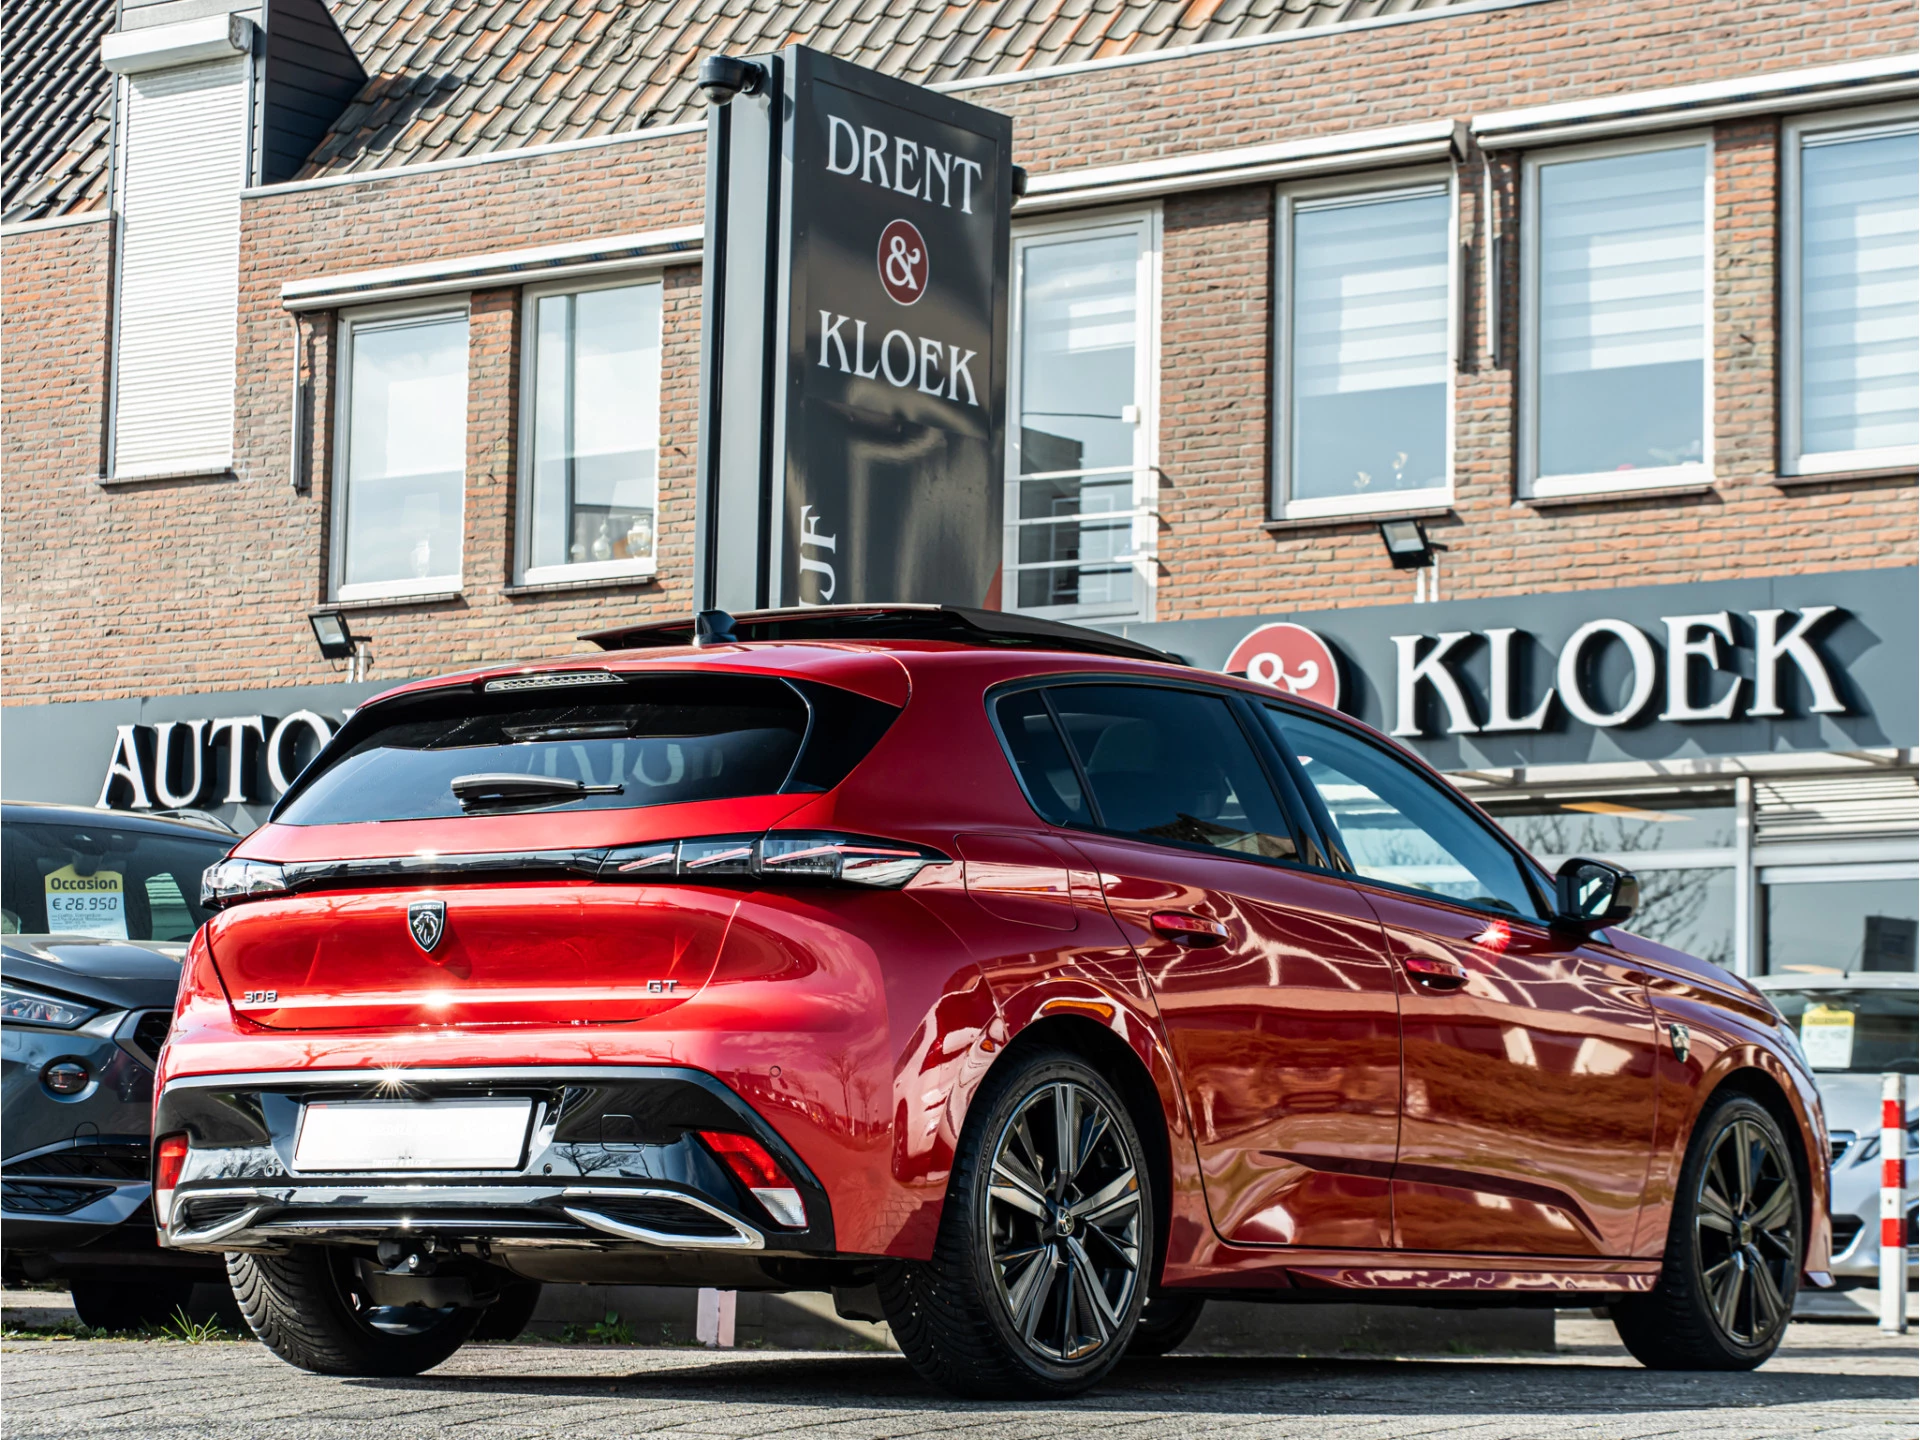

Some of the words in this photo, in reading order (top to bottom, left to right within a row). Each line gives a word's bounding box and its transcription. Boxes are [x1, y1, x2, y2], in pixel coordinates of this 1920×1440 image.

[825, 114, 982, 214] DRENT
[885, 235, 921, 290] &
[817, 309, 980, 406] KLOEK
[799, 505, 836, 607] JF
[1390, 605, 1846, 737] KLOEK
[95, 708, 357, 809] AUTO
[51, 877, 118, 890] Occasion
[52, 897, 62, 910] €
[65, 897, 117, 910] 26.950
[244, 990, 278, 1003] 308
[647, 979, 678, 993] GT
